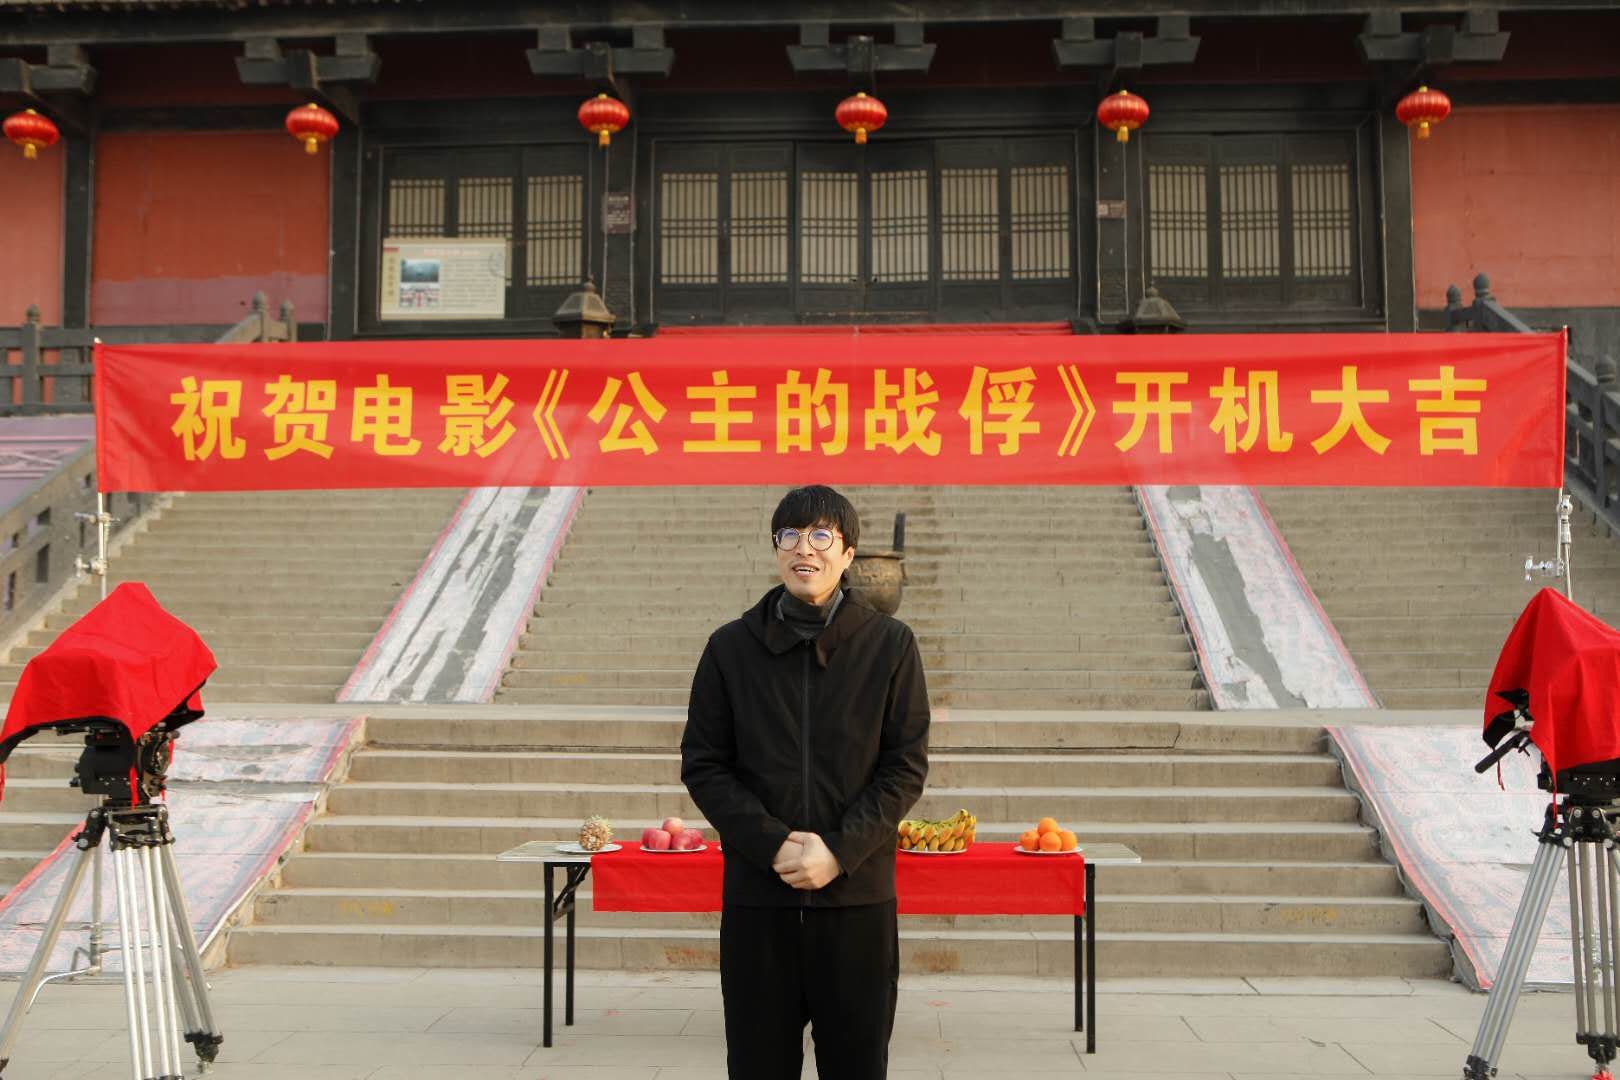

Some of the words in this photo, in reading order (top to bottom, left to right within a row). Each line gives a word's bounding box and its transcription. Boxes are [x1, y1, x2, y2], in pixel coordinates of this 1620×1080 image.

[170, 365, 1487, 462] 祝贺电影《公主的战俘》开机大吉
